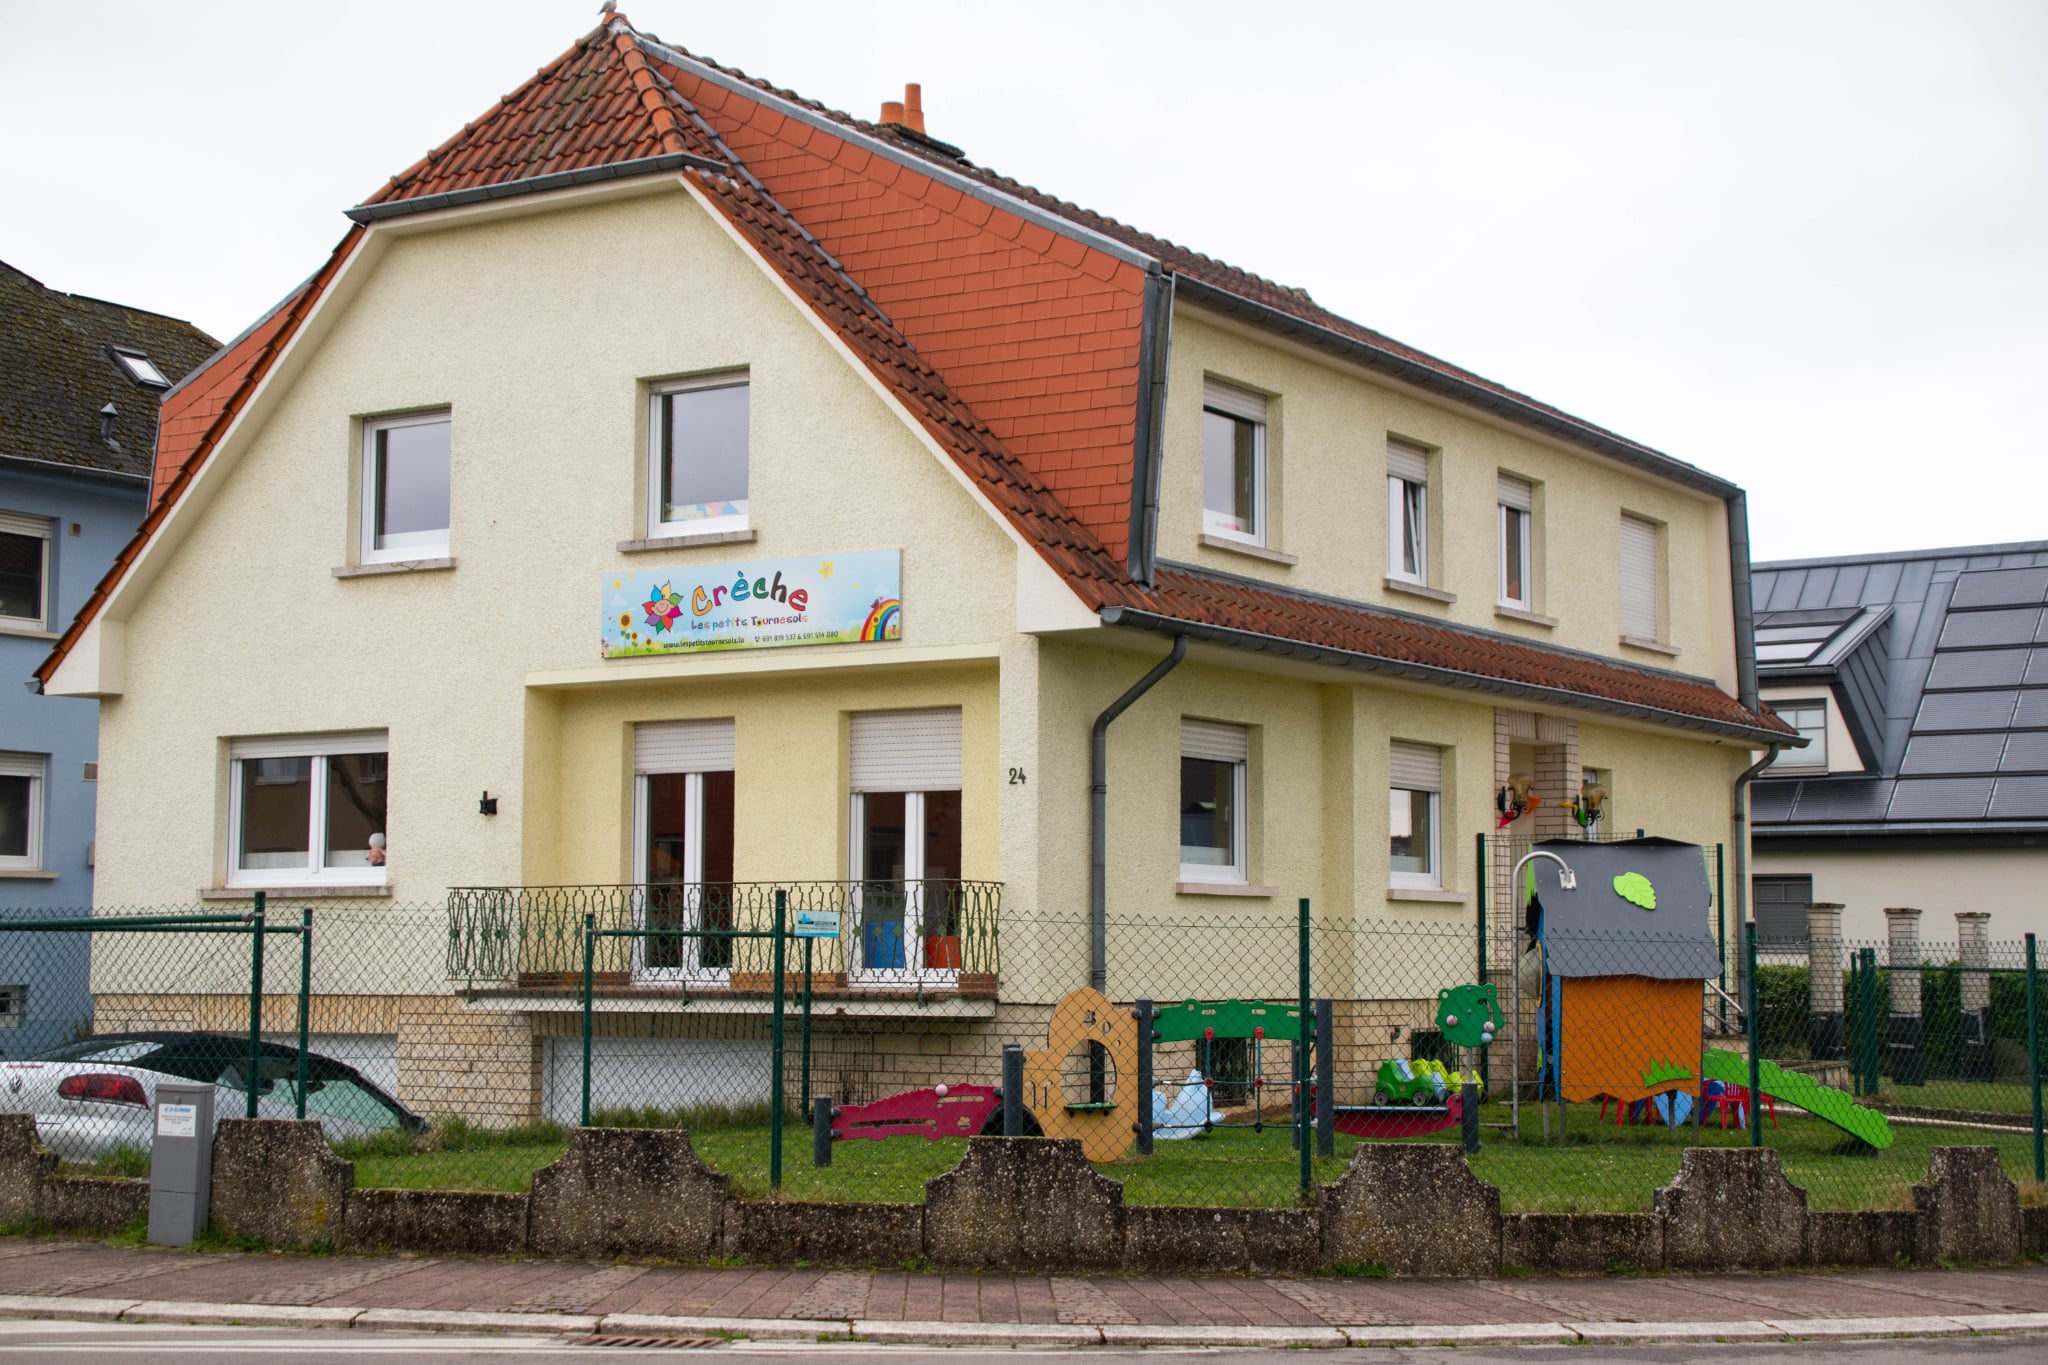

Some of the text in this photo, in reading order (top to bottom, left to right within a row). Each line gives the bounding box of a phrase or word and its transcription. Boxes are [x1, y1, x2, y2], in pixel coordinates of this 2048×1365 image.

[691, 570, 808, 616] Crèche
[691, 613, 809, 632] Les petits Tournesols
[663, 637, 745, 649] www.lespetitstournesols.lu
[762, 635, 773, 643] 691
[785, 633, 796, 641] 537
[803, 632, 814, 641] 691
[814, 631, 825, 640] 514
[826, 630, 839, 639] 080
[1008, 767, 1027, 785] 24
